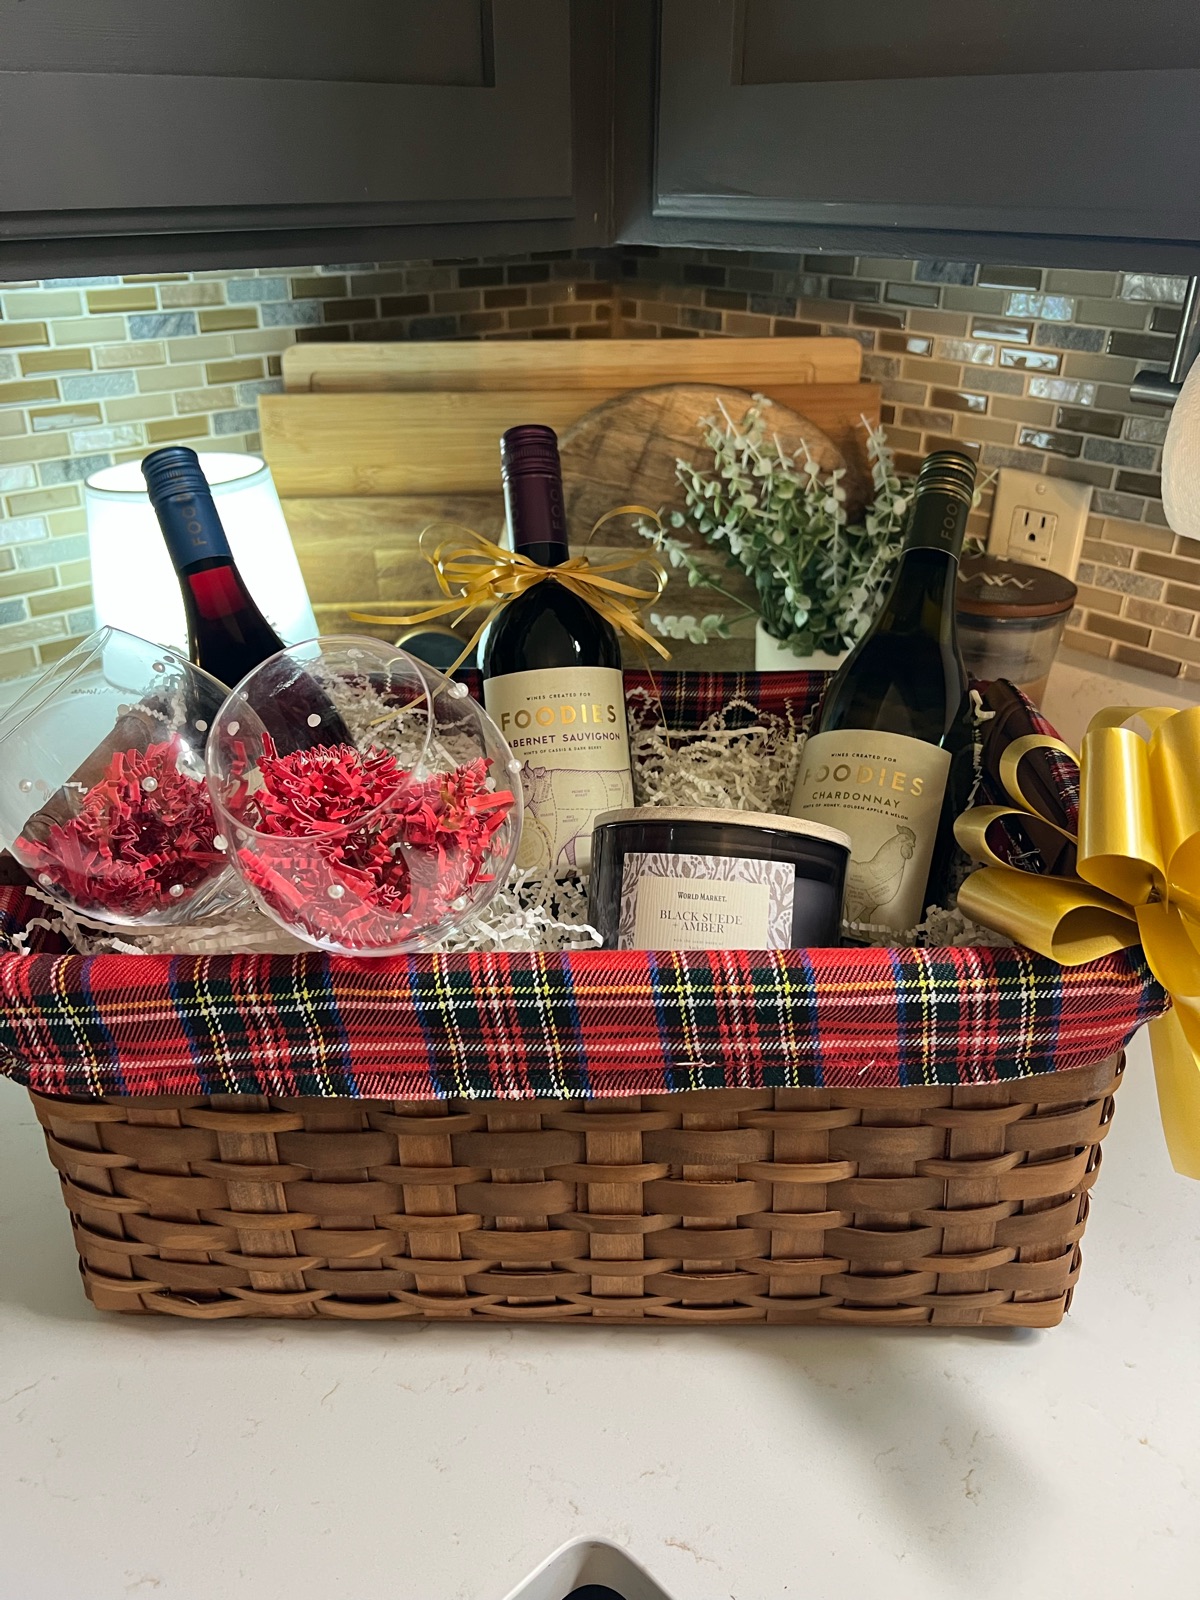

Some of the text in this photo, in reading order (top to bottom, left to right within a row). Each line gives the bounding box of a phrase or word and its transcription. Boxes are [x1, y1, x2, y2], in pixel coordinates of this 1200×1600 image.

[940, 495, 960, 541] FOO
[501, 704, 616, 731] FOODIES
[562, 732, 620, 743] SAUVIGNON
[851, 752, 881, 760] CREATED
[803, 764, 923, 796] FOODIES
[812, 791, 901, 808] CHARDONNAY
[890, 812, 909, 820] MELON
[678, 891, 699, 900] WORLD
[660, 909, 743, 925] BLACK SUEDE
[681, 921, 724, 933] AMBER
